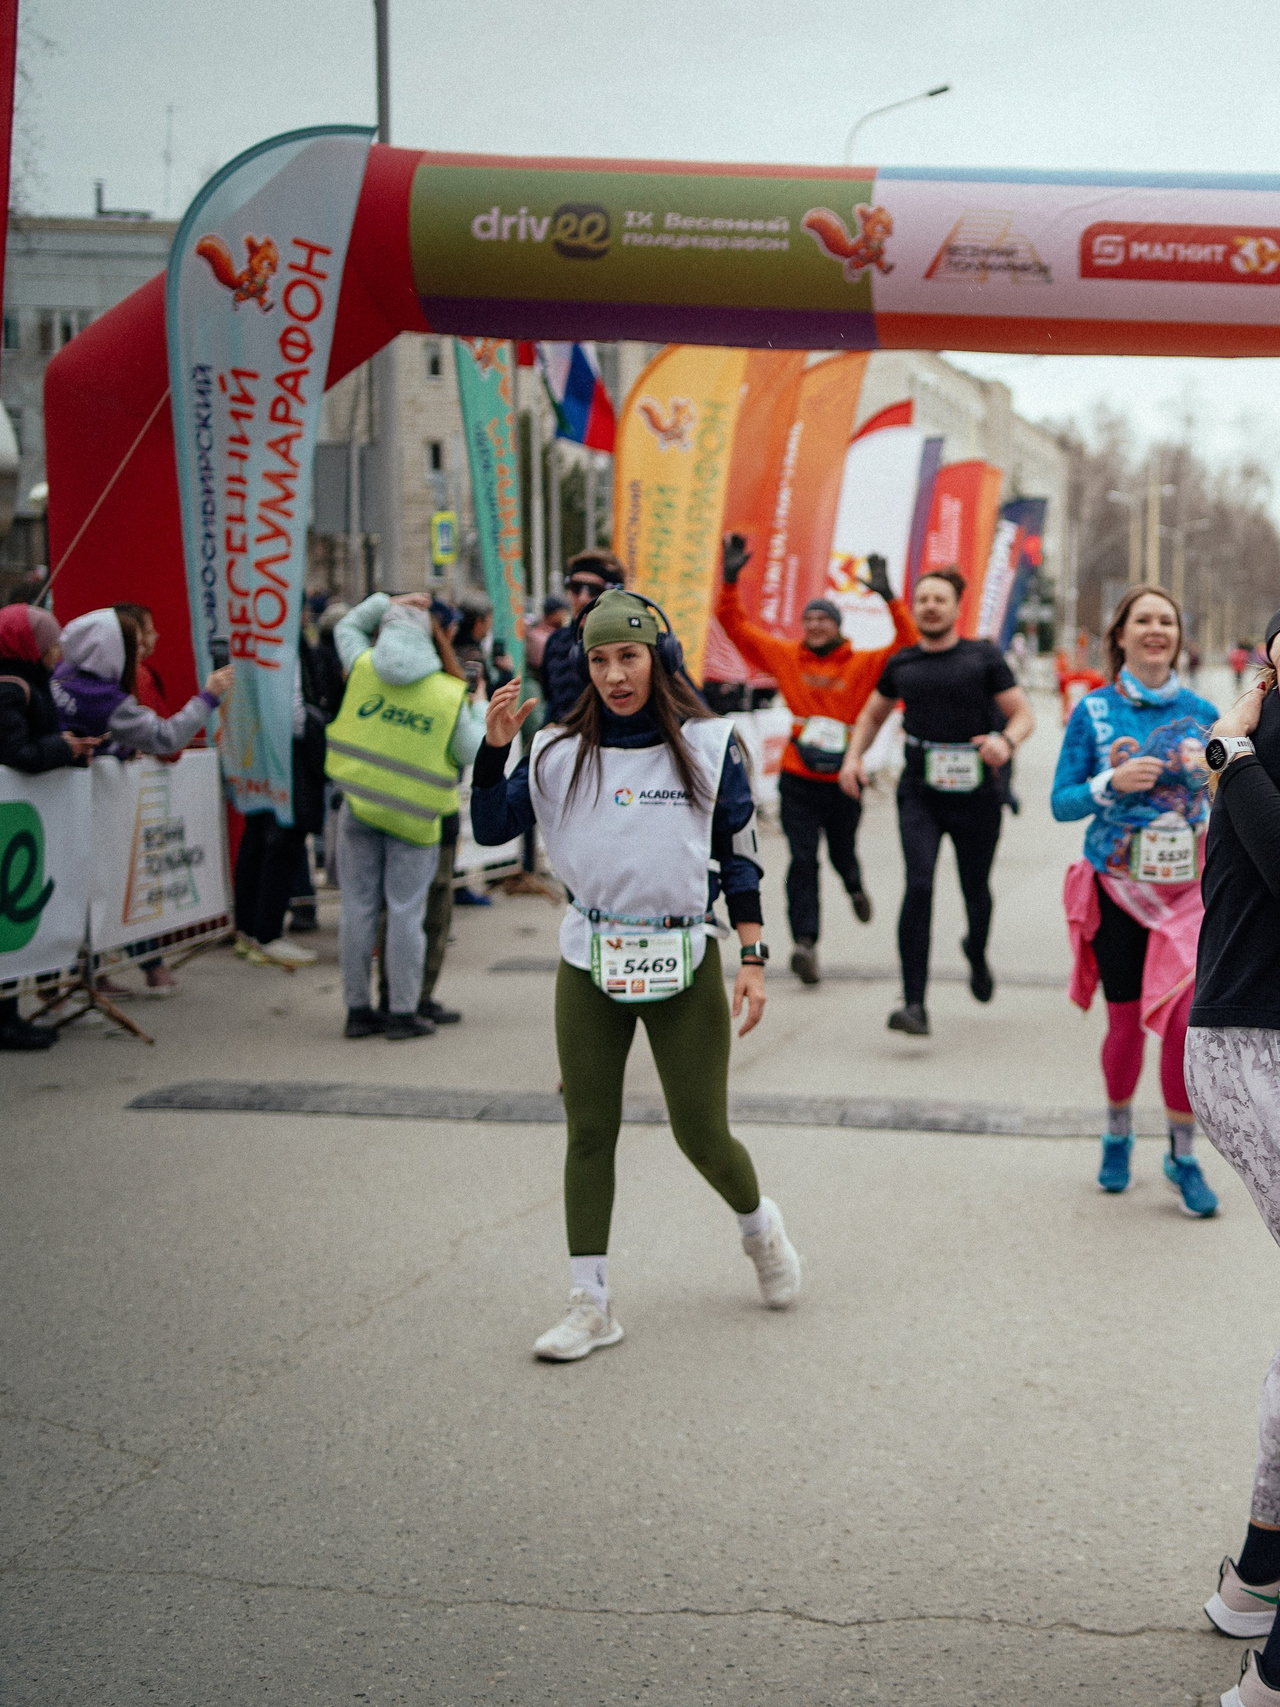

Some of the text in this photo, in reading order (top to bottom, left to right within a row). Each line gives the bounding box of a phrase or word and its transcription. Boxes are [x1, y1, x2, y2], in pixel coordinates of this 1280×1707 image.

[472, 206, 610, 250] drivee
[1130, 241, 1228, 263] МАГНИТ
[253, 236, 332, 671] ПОЛУМАРАФОН
[219, 366, 259, 661] ВЕСЕННИЙ
[381, 704, 435, 734] asics
[623, 958, 677, 975] 5469
